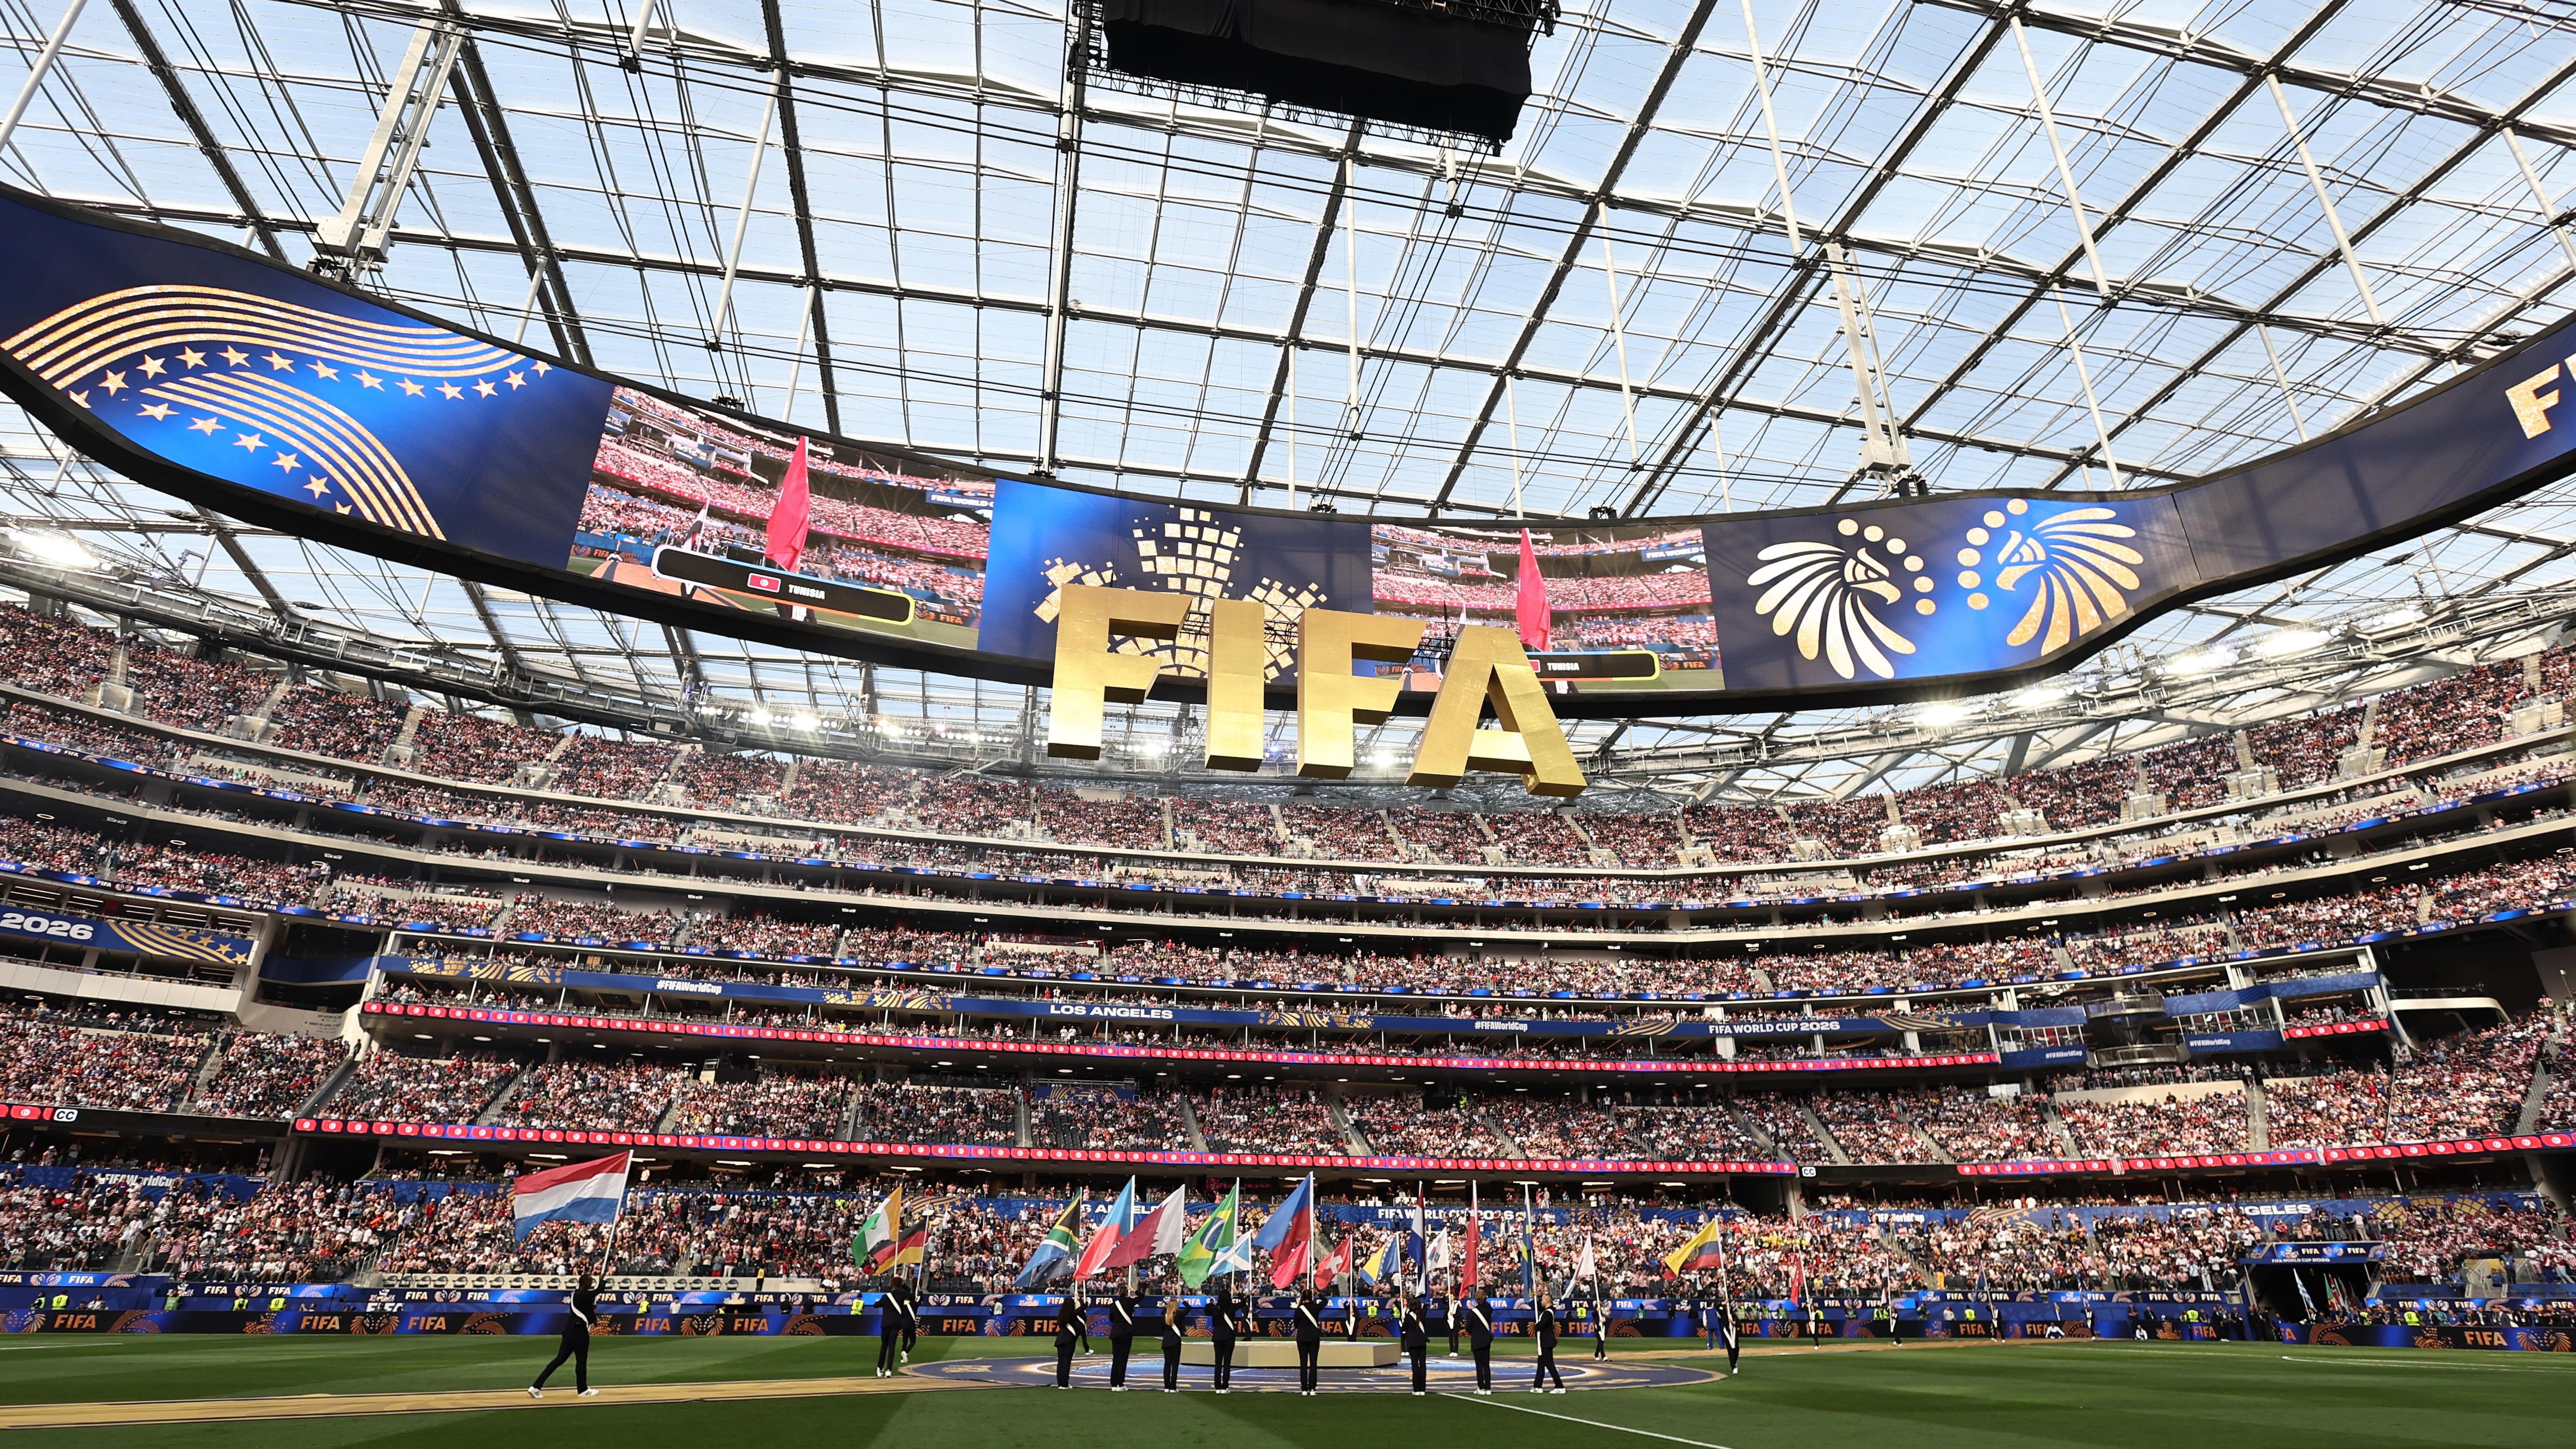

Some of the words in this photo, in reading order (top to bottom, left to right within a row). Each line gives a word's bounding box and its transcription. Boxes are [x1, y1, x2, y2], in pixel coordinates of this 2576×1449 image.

[2505, 352, 2576, 439] F
[931, 495, 952, 503] FIFA
[953, 497, 988, 507] WORLD
[594, 549, 609, 557] FIFA
[1646, 551, 1666, 559] FIFA
[1666, 547, 1699, 557] WORLD
[788, 584, 825, 600] TUNISIA
[940, 614, 963, 624] FIFA
[1547, 662, 1580, 671] TUNISIA
[1048, 584, 1587, 797] FIFA
[0, 913, 94, 940] 2026
[656, 980, 722, 995] #FIFAWorldCup
[1050, 1005, 1086, 1014] LOS
[1090, 1007, 1173, 1019] ANGELES
[1475, 1021, 1528, 1032] #FIFAWorldCup
[1709, 1025, 1732, 1033] FIFA
[1733, 1024, 1774, 1033] WORLD
[1776, 1022, 1798, 1032] CUP
[1800, 1021, 1840, 1031] 2026
[2190, 1038, 2231, 1047] #FIFAWorldCup
[57, 1111, 75, 1120] CC
[54, 1315, 95, 1328] FIFA
[301, 1316, 339, 1329] FIFA
[408, 1317, 446, 1329] FIFA
[635, 1318, 670, 1331] FIFA
[734, 1319, 768, 1331] FIFA
[943, 1320, 976, 1332] FIFA
[1033, 1320, 1060, 1332] FIF
[1491, 1322, 1519, 1333] FIFA
[1960, 1324, 1985, 1334] FIFA
[2193, 1326, 2217, 1338] FIFA
[2465, 1332, 2507, 1345] FIFA
